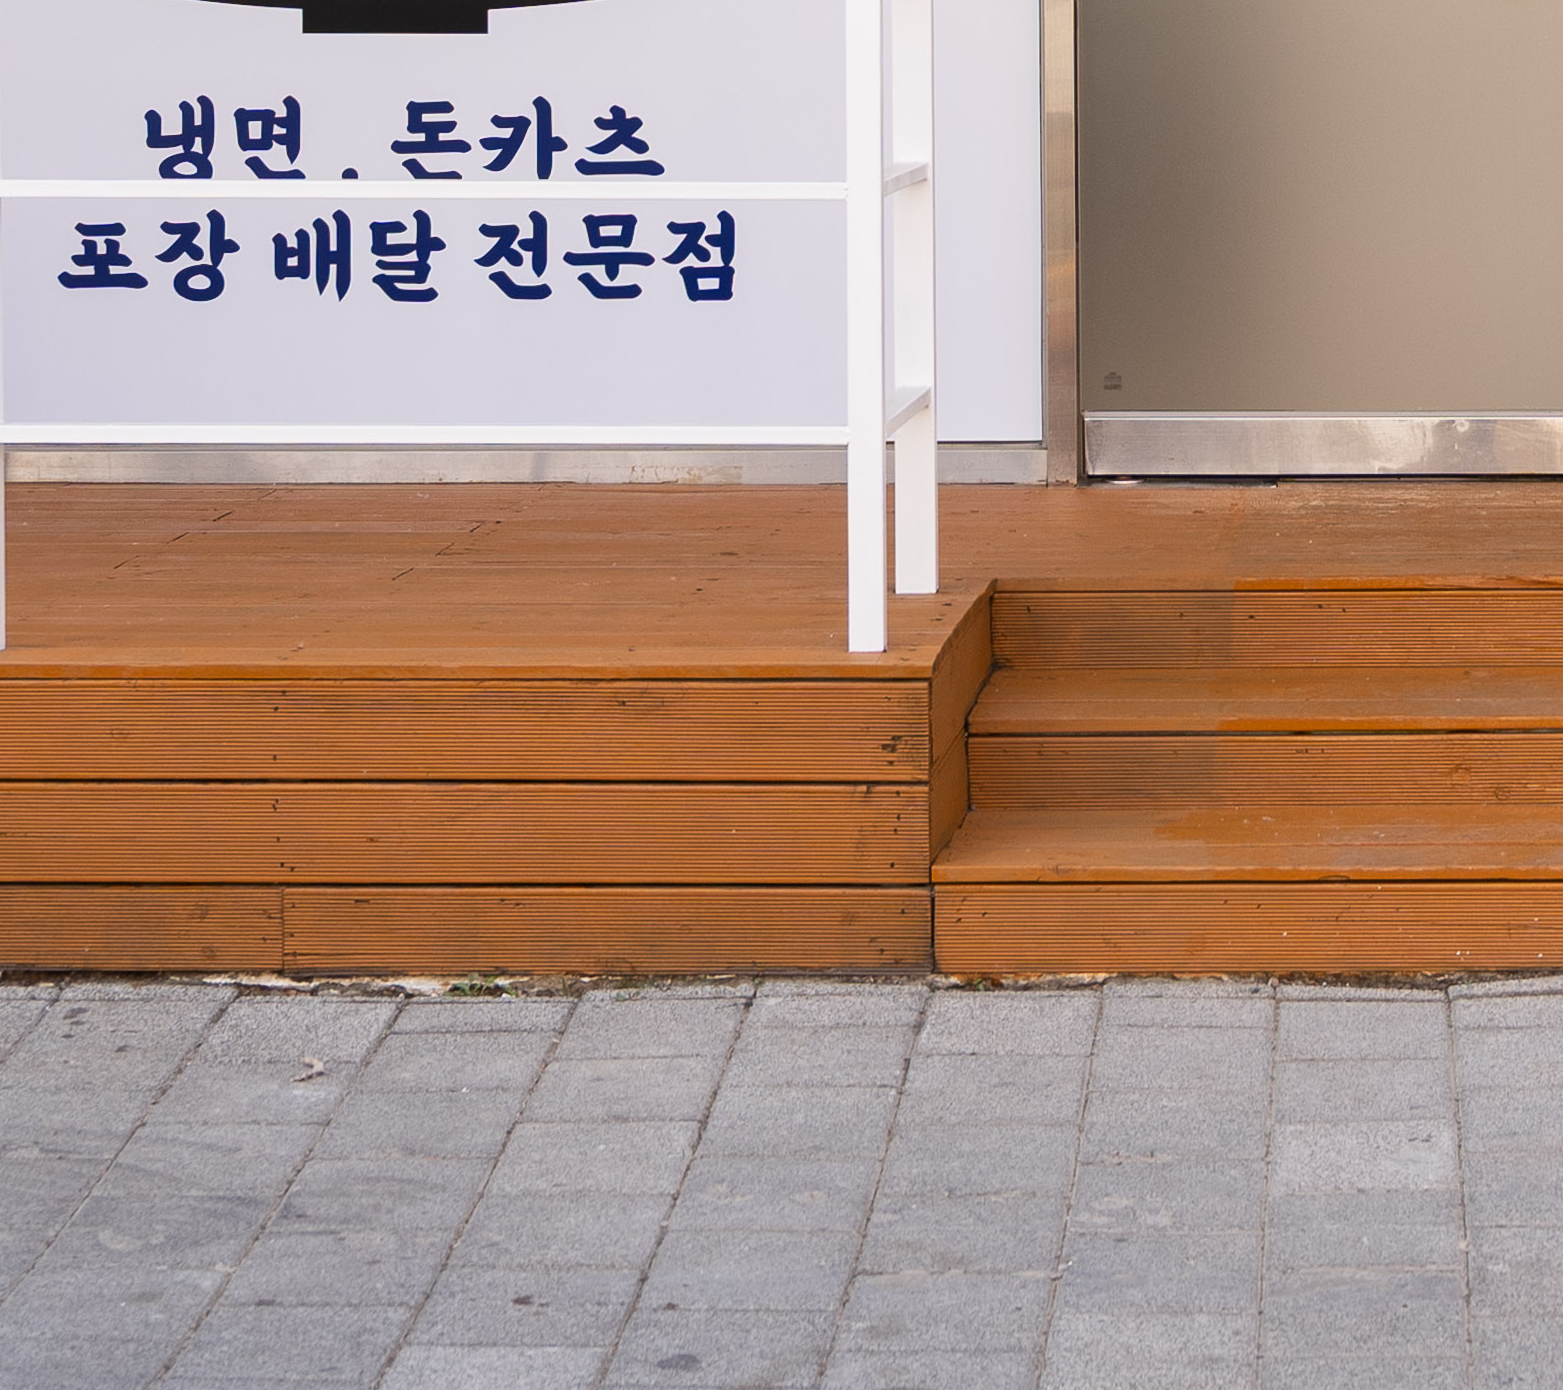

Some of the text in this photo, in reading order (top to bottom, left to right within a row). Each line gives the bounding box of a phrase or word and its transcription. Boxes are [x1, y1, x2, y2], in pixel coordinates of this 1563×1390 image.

[144, 95, 665, 179] 냉면 돈카츠
[57, 209, 736, 303] 포장 배달 전문점
